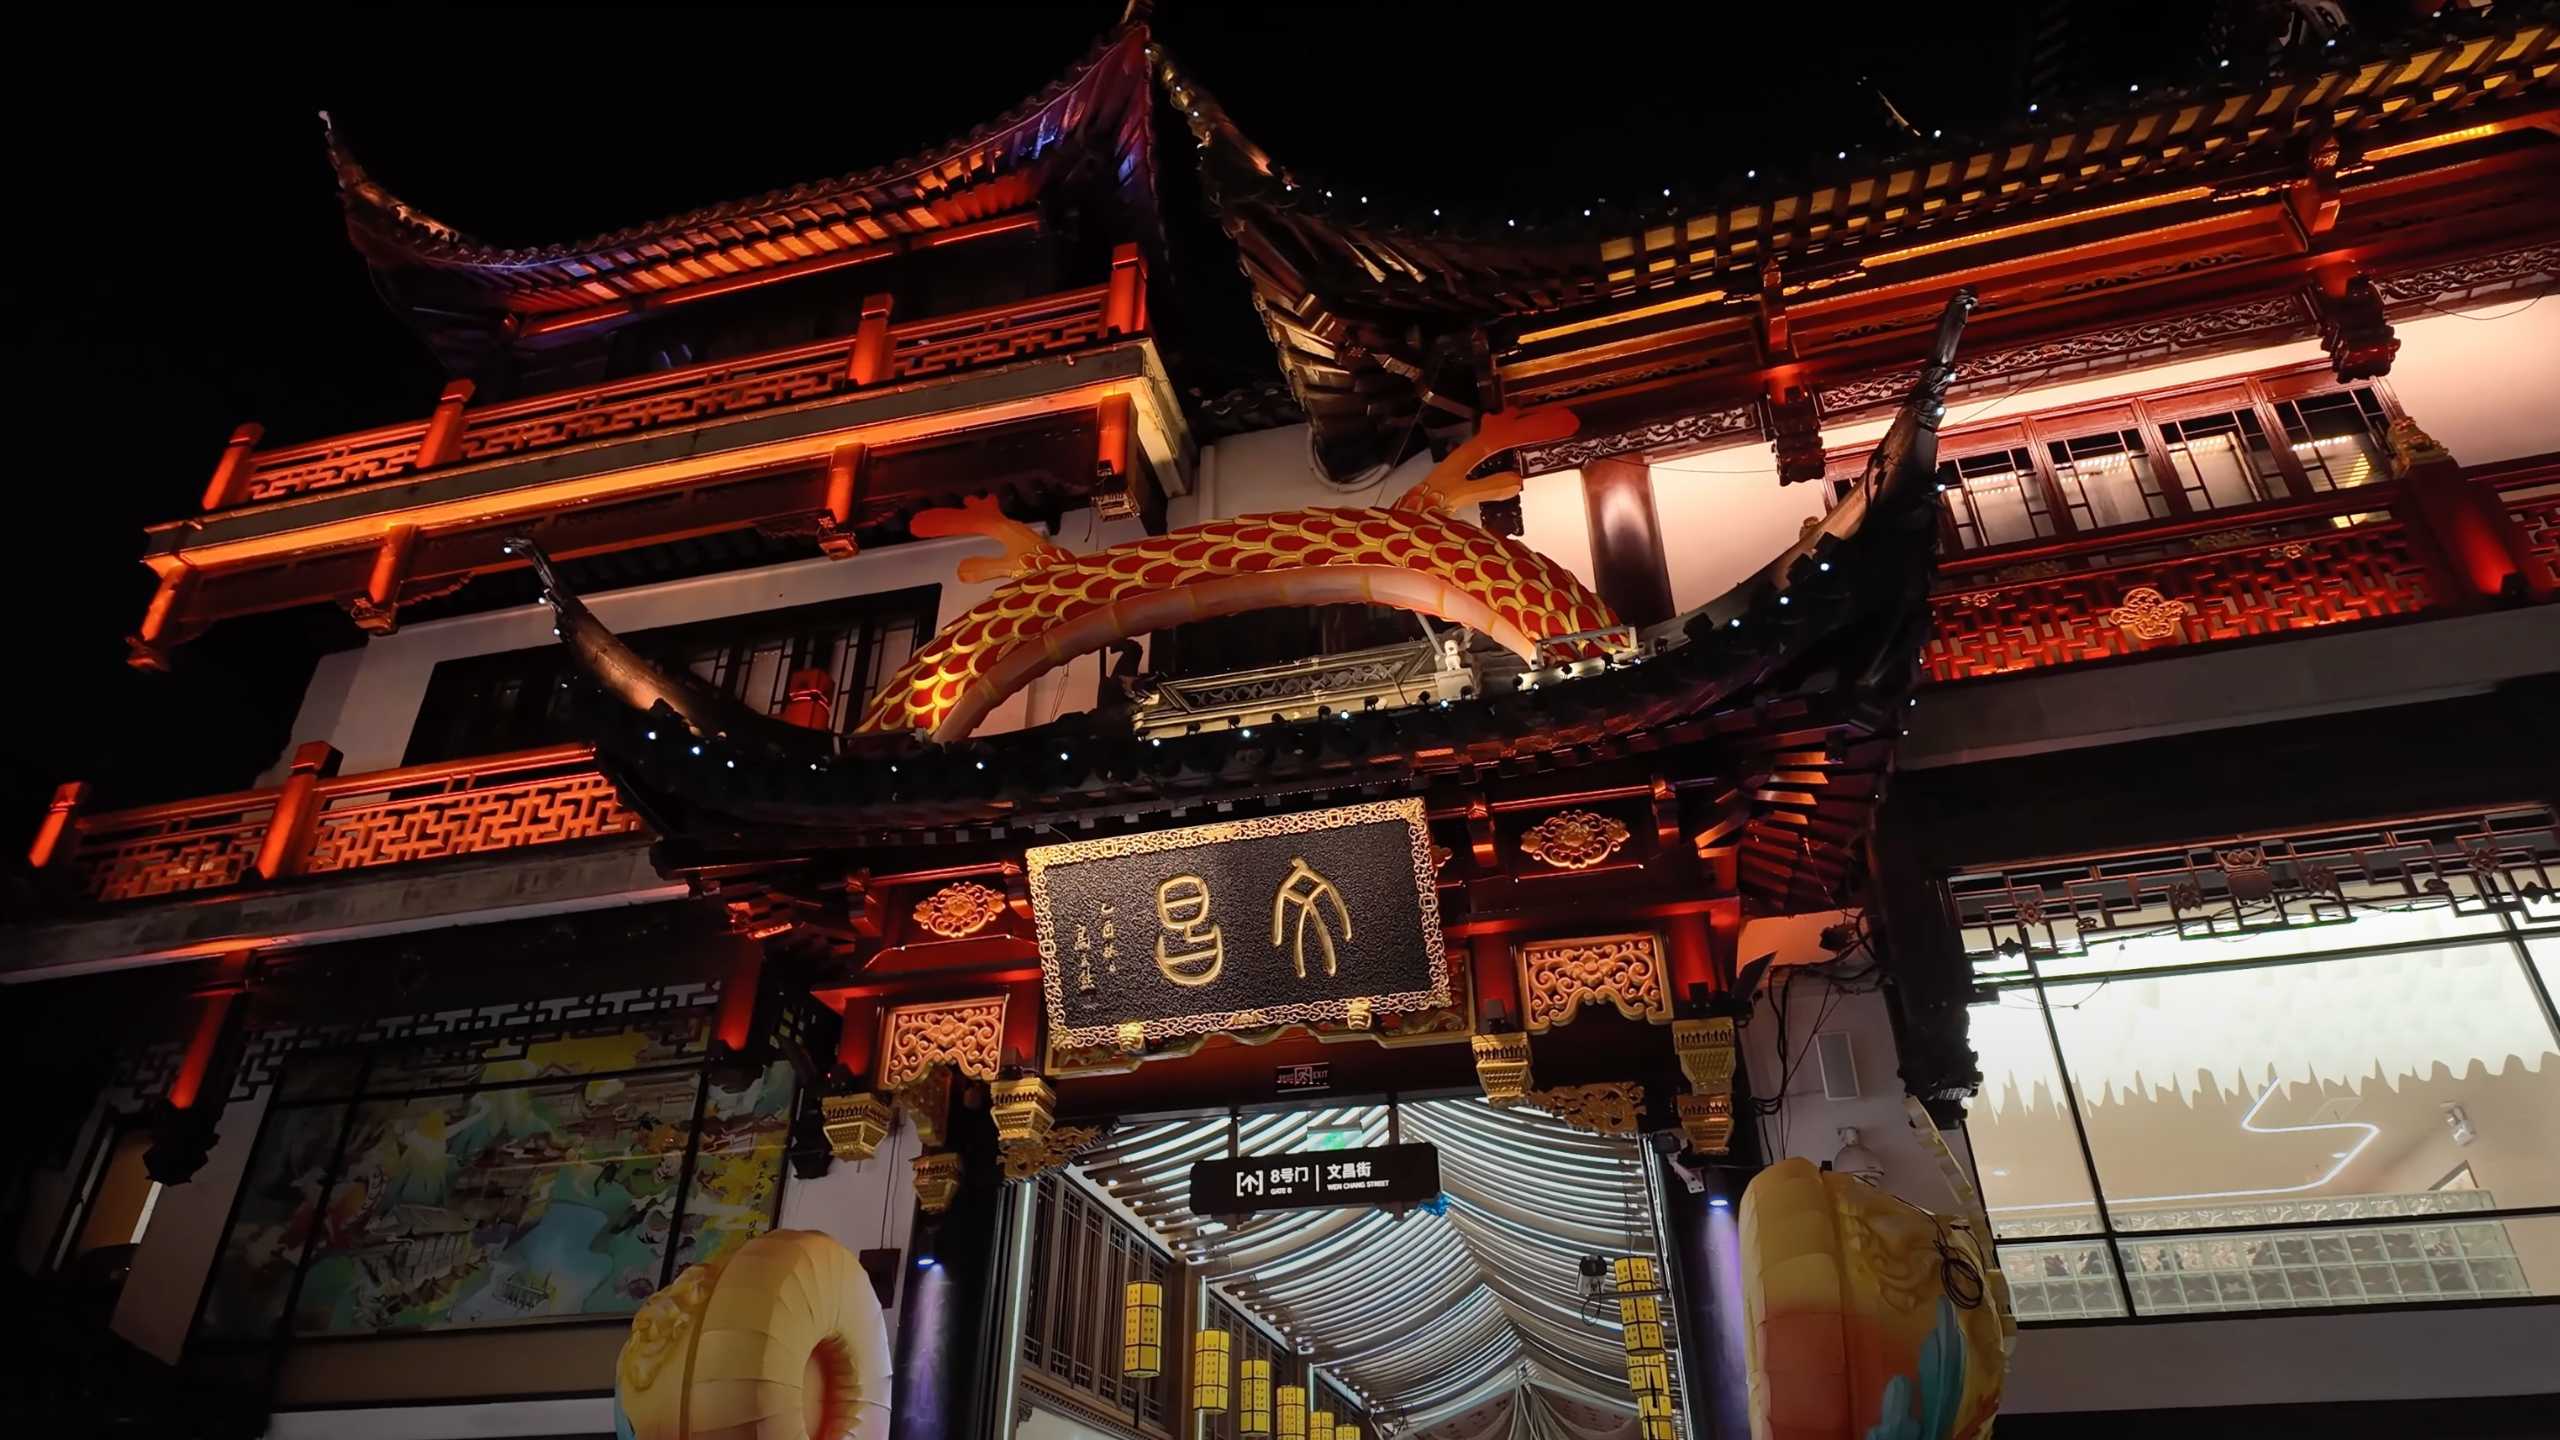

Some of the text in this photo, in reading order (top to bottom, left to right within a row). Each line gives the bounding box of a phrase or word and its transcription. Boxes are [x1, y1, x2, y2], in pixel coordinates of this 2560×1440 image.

[1270, 1166, 1309, 1183] 8号门
[1326, 1161, 1371, 1180] 文昌街
[1270, 1187, 1286, 1195] GATE
[1327, 1180, 1390, 1191] WEN CHANG STREET
